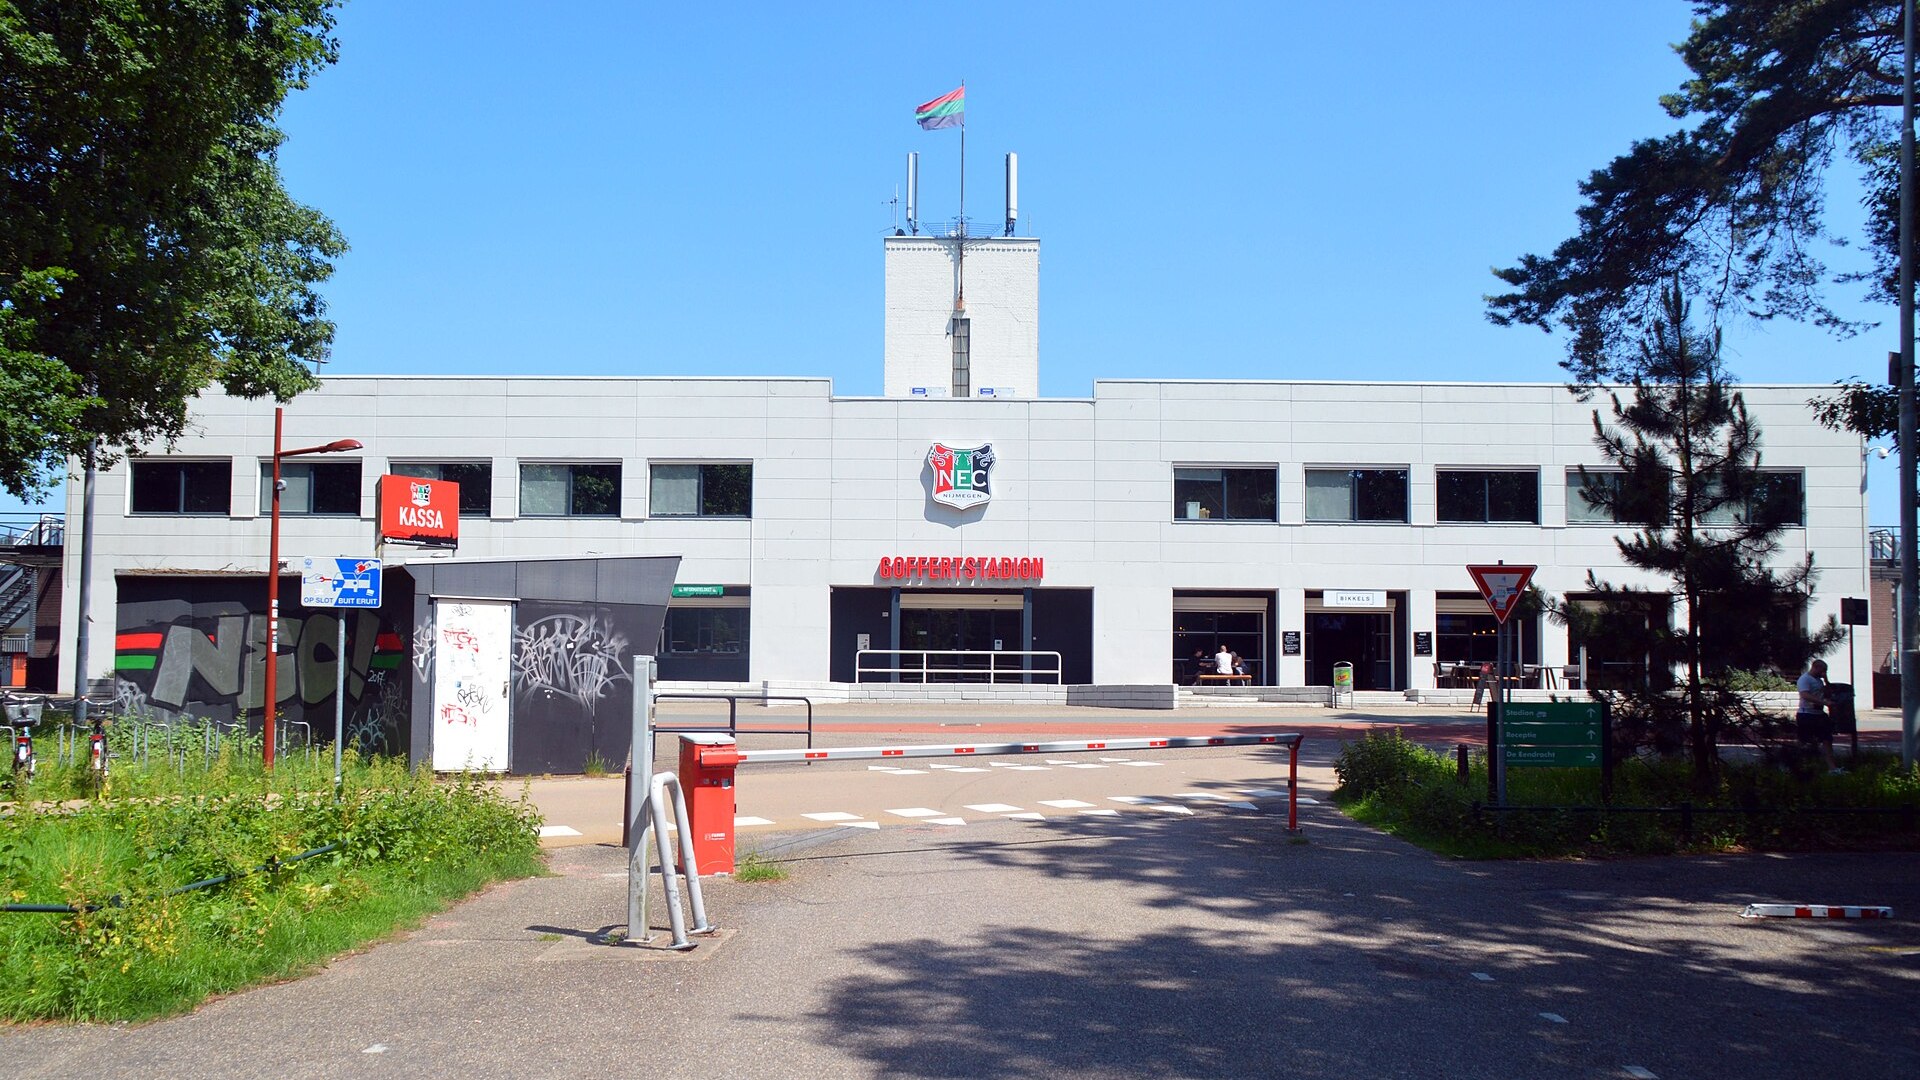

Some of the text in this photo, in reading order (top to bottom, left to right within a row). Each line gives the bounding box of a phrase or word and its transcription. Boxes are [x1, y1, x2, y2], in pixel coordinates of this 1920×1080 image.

[939, 469, 987, 487] NEC
[399, 506, 444, 529] KASSA
[879, 556, 1044, 579] GOFFERTSTADION
[1506, 731, 1537, 739] Receptie
